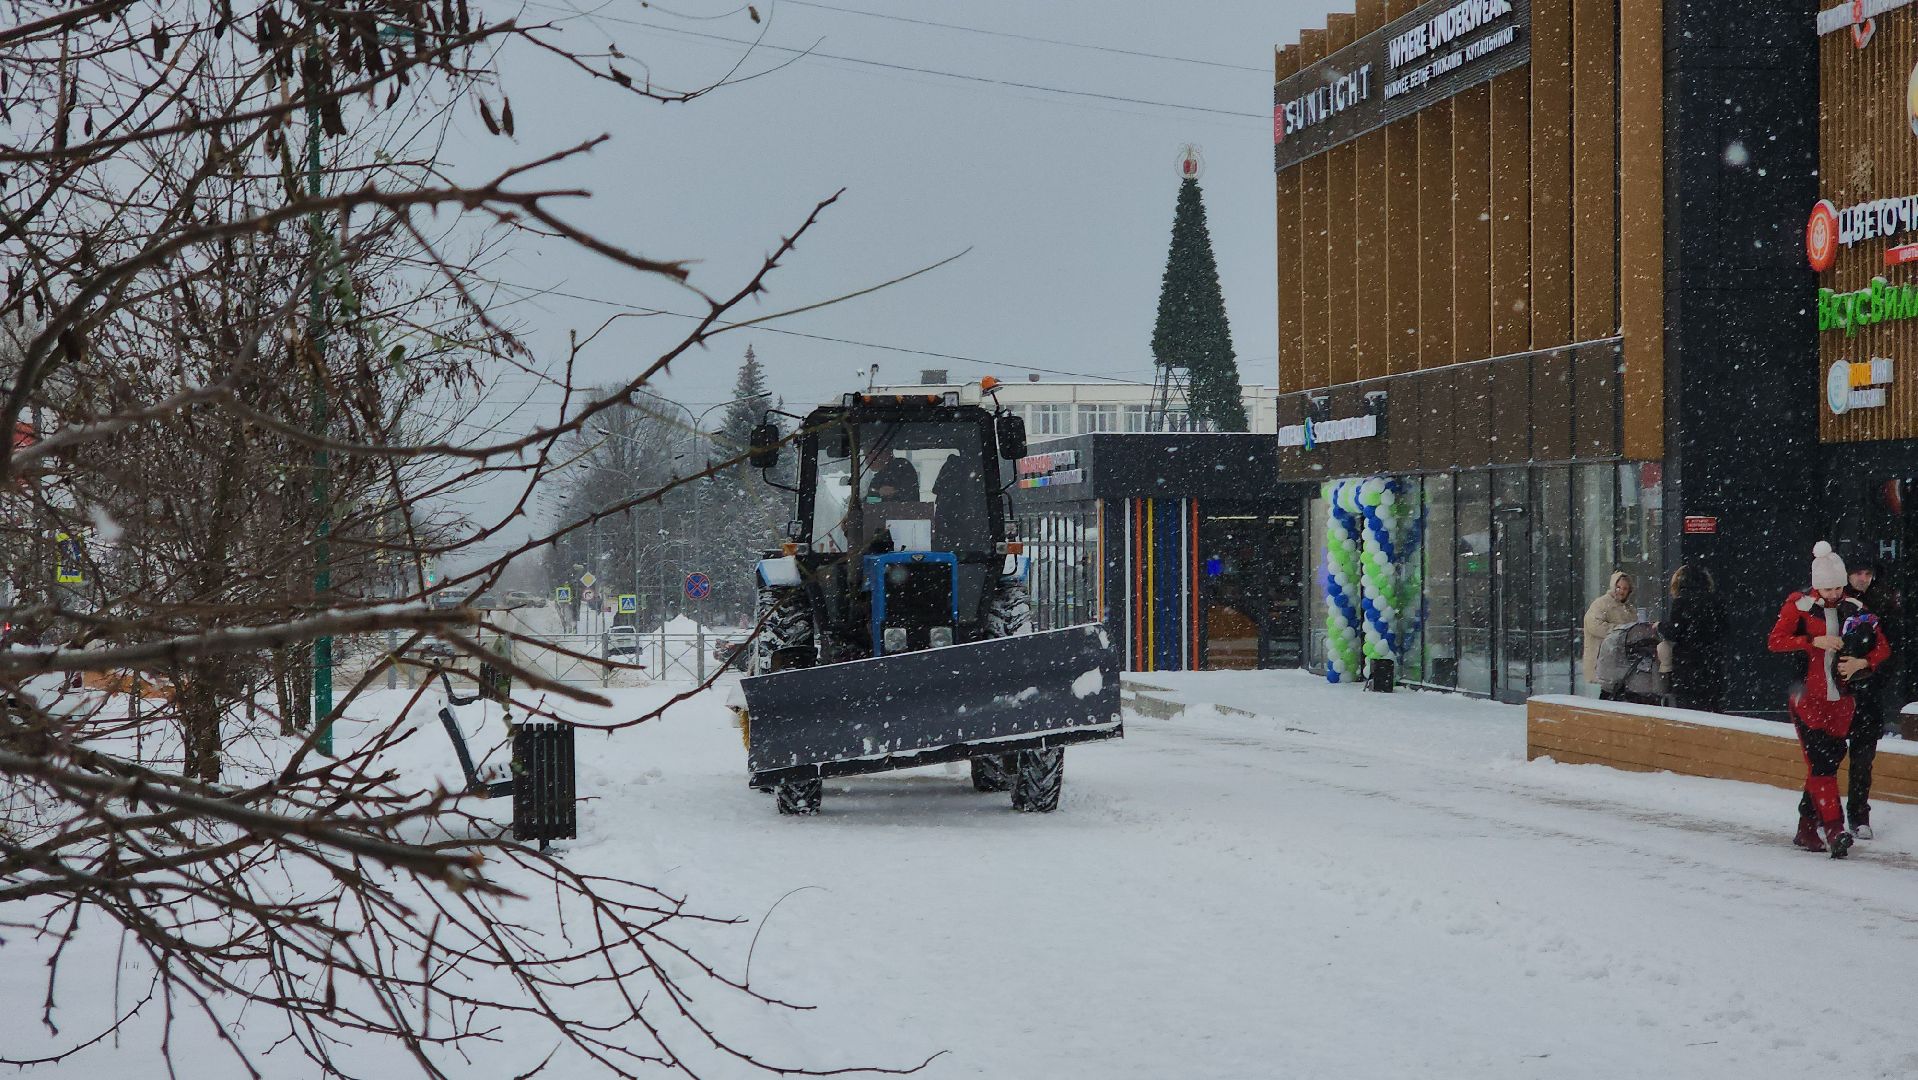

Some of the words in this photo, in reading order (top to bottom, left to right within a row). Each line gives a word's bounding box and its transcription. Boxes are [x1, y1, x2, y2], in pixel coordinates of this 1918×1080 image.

[1389, 22, 1427, 69] WHERE
[1465, 26, 1514, 63] КУПАЛЬНИКИ
[1286, 63, 1370, 135] SUNLIGHT
